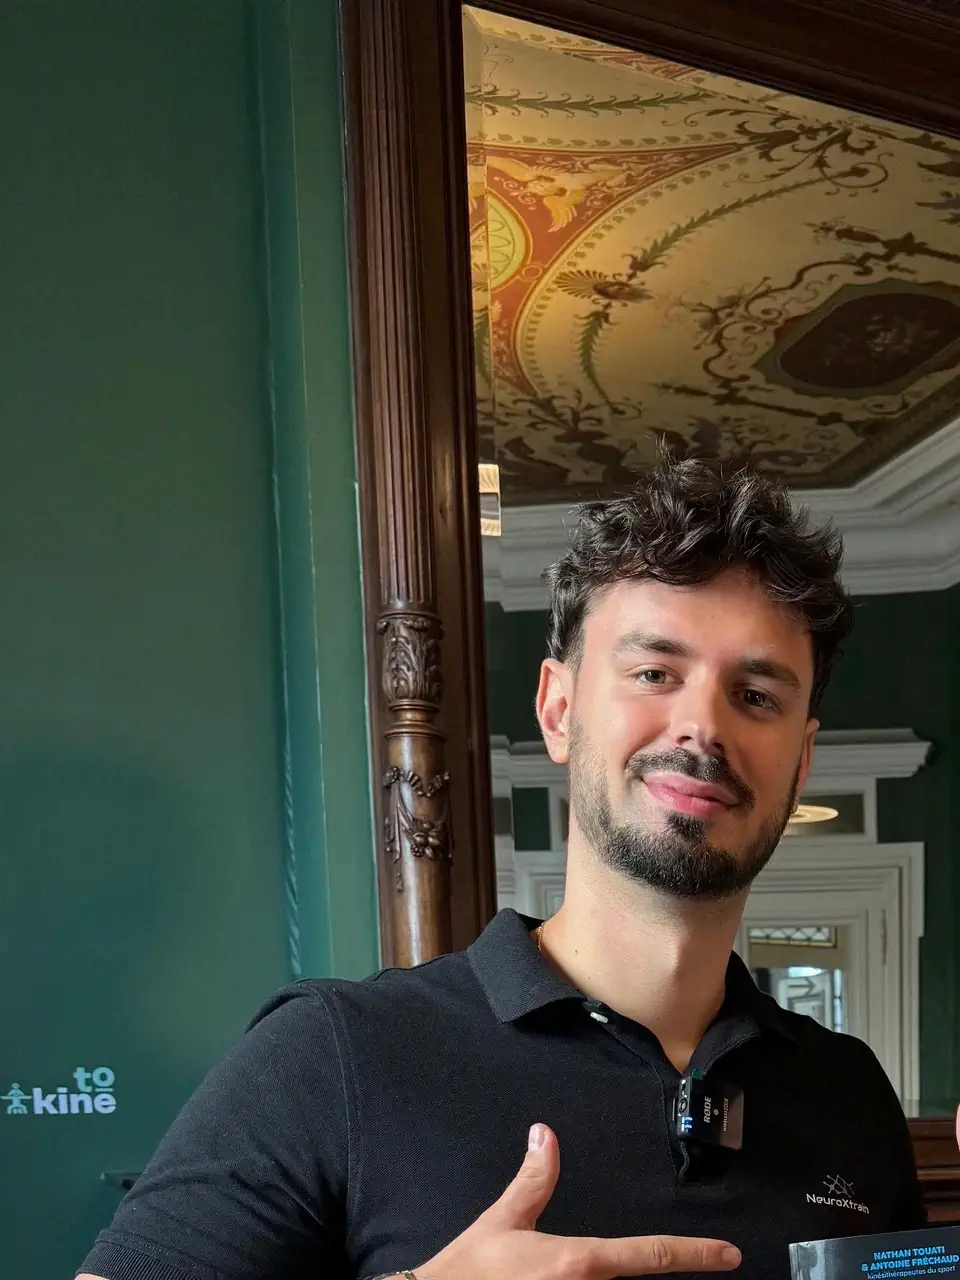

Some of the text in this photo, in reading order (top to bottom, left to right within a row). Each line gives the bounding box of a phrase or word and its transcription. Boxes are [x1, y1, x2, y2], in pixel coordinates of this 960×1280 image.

[806, 1193, 870, 1215] NeuroXtrain
[873, 1245, 945, 1260] NATHAN TOUATI
[861, 1254, 960, 1272] & ANTOINE FRÉCHAUD
[927, 1266, 937, 1274] du
[937, 1265, 956, 1275] sport
